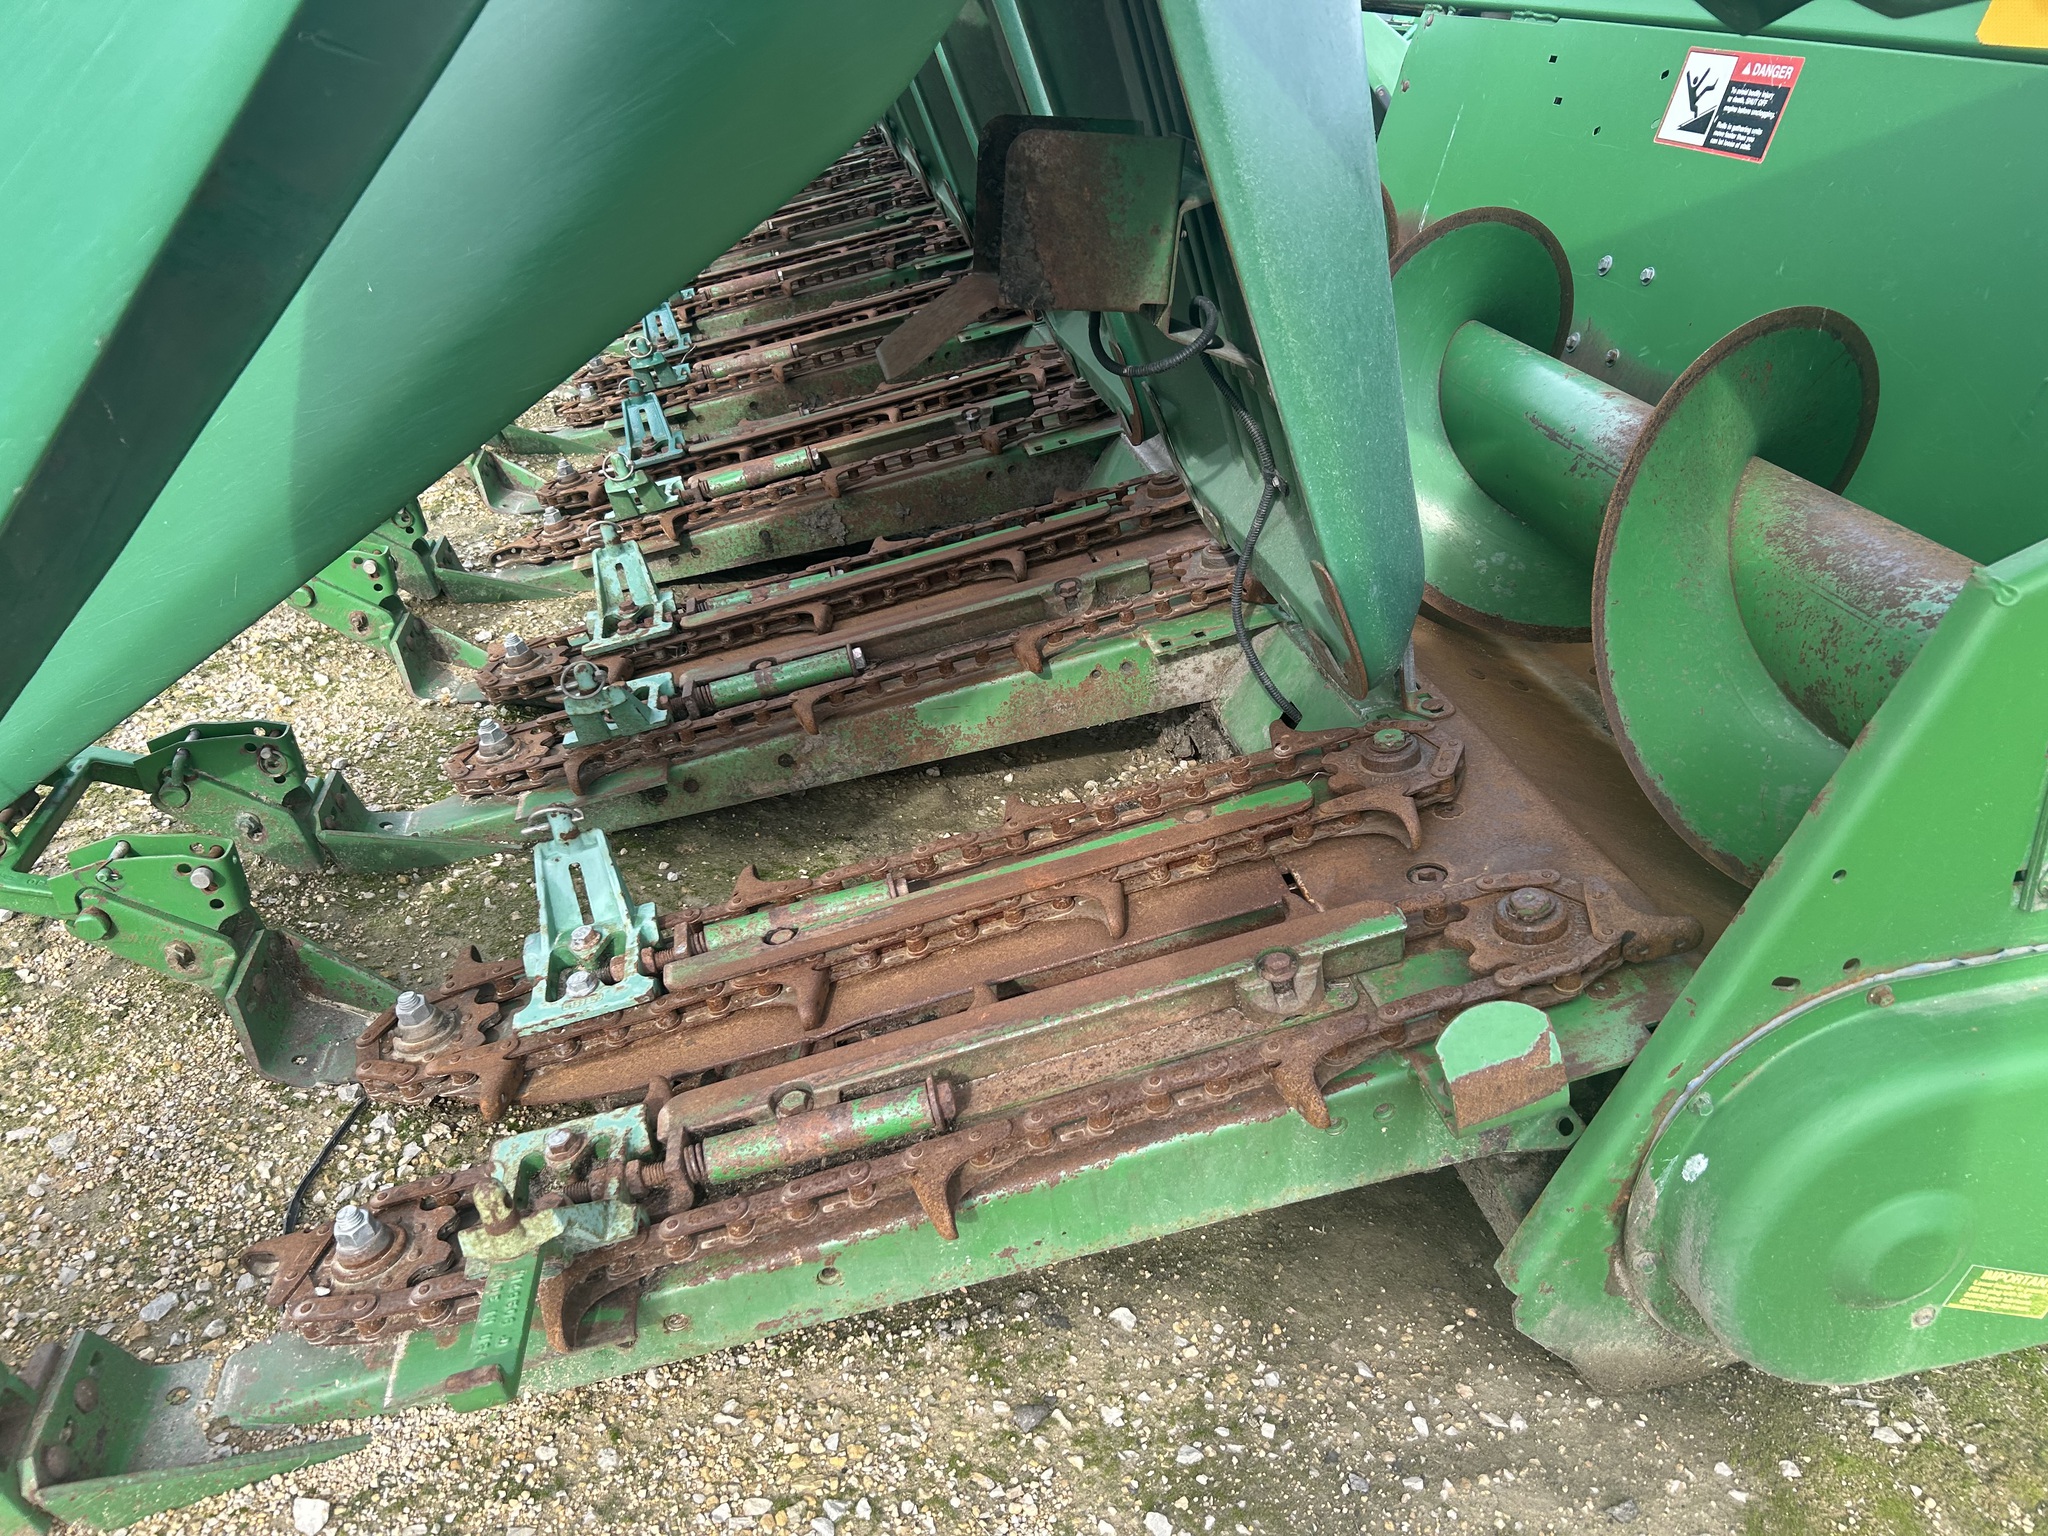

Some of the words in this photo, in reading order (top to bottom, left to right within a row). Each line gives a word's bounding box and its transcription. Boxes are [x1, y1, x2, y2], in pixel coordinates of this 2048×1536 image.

[1752, 63, 1794, 79] DANGER
[1745, 97, 1758, 106] SHUT
[1757, 99, 1768, 107] OFF
[1980, 1269, 2048, 1287] IMPORTAN
